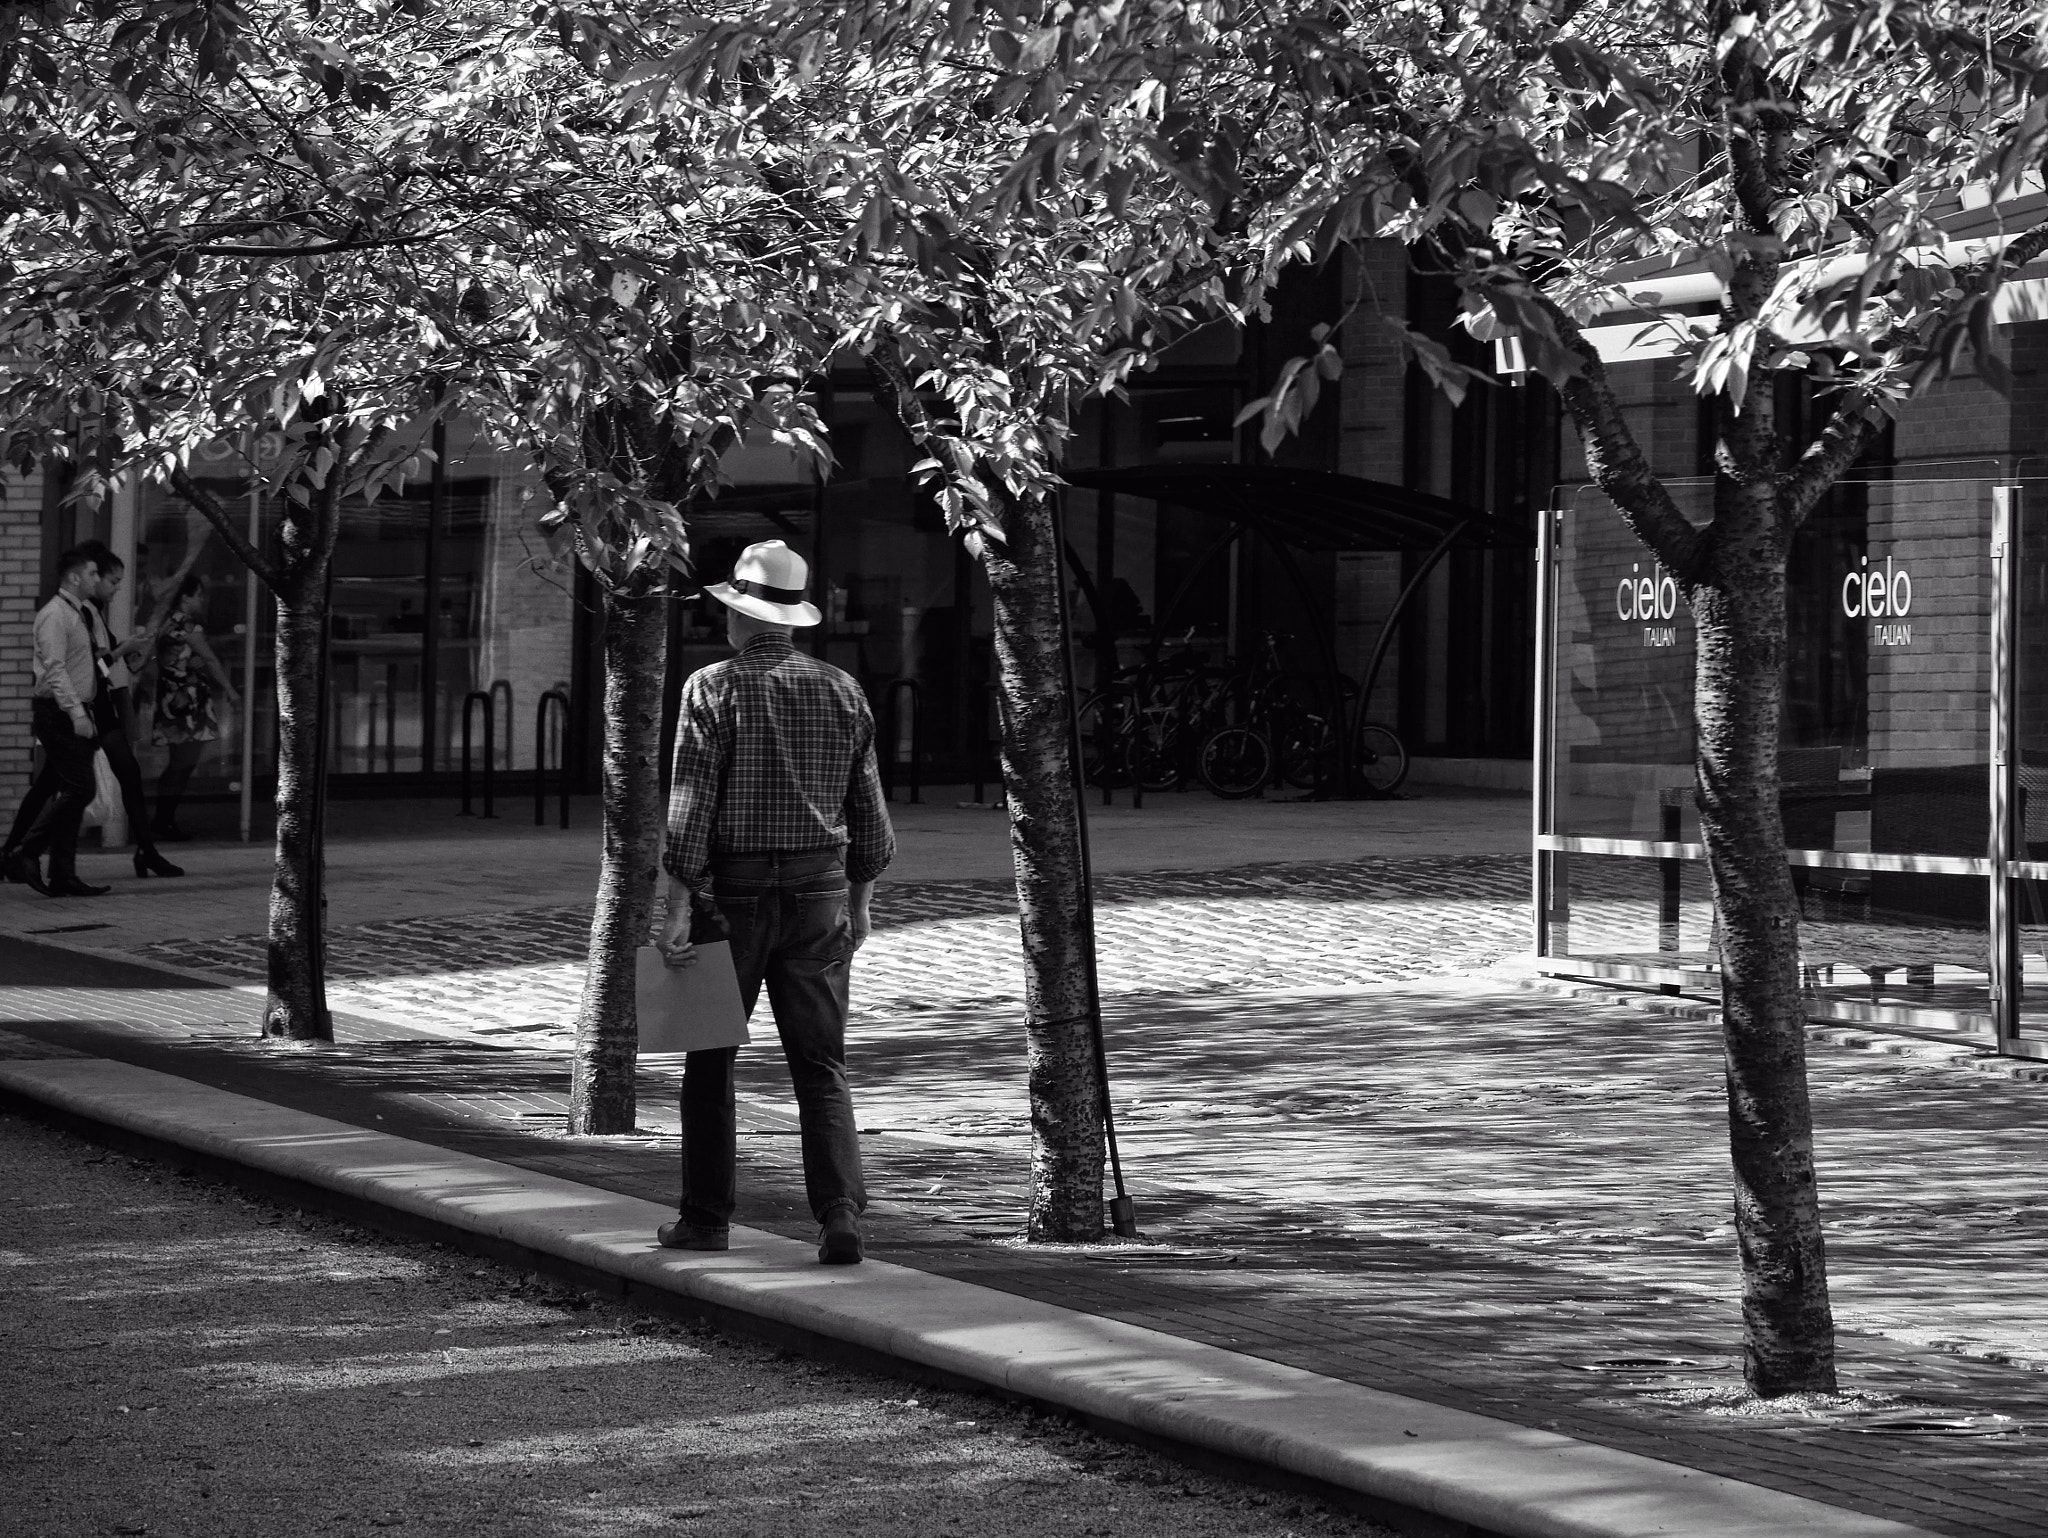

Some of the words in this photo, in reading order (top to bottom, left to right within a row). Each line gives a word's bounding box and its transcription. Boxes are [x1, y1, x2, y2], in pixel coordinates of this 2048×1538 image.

[1616, 563, 1677, 621] cielo
[1842, 555, 1912, 618] cielo
[1643, 627, 1677, 647] ITALIAN
[1873, 624, 1912, 646] ITALIAN
